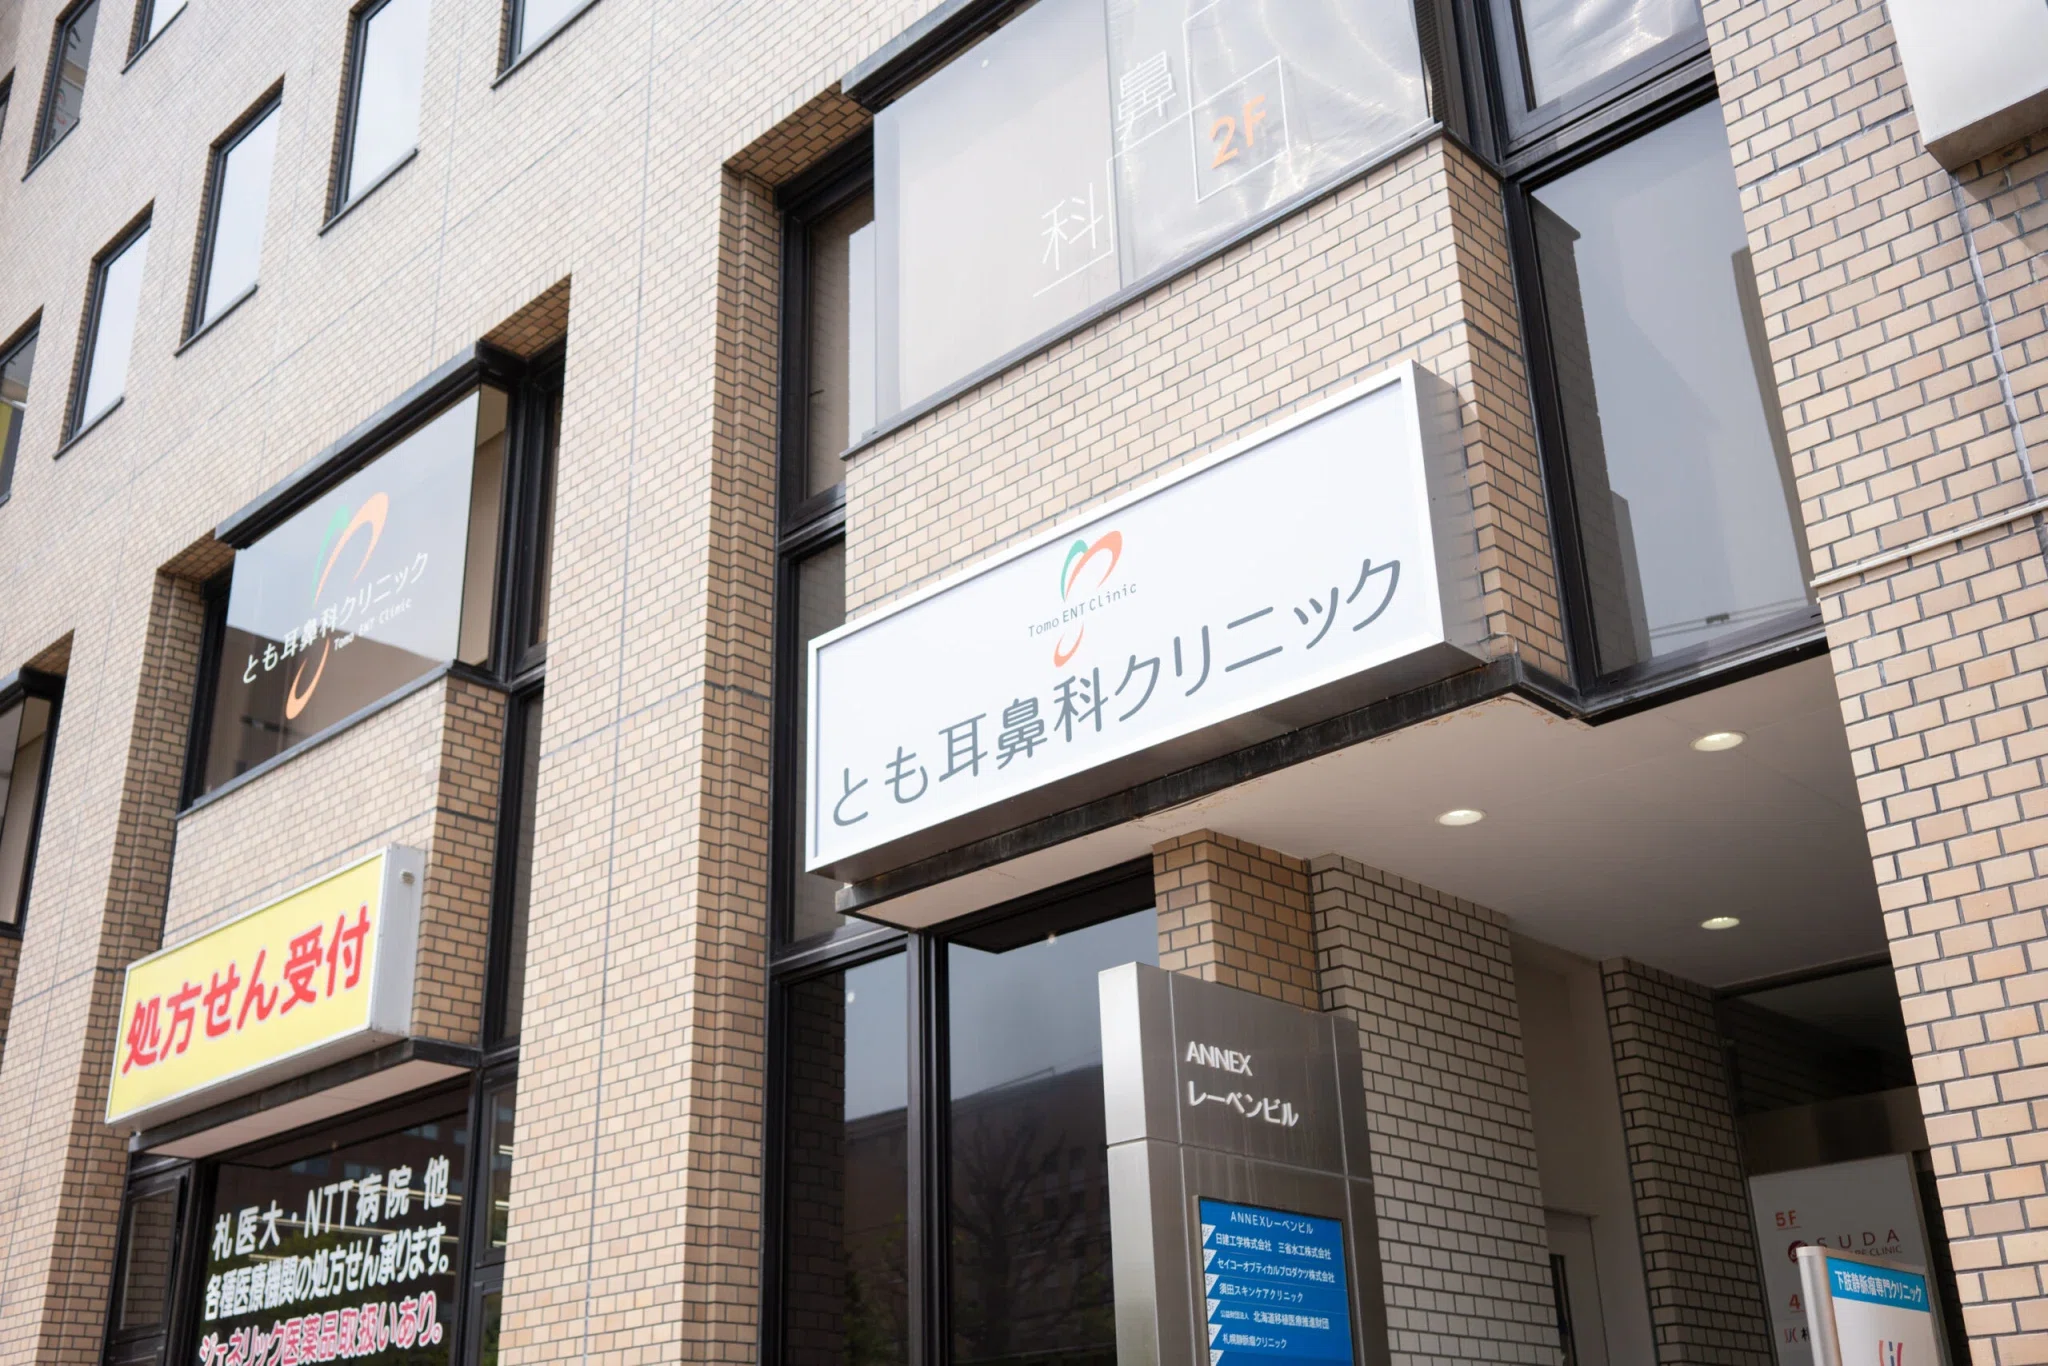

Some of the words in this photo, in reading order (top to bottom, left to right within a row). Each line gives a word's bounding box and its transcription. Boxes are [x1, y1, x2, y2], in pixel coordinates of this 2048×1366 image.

[1209, 94, 1267, 170] 2F
[1041, 182, 1104, 271] 科
[243, 552, 429, 684] とも耳鼻科クリニック
[1028, 617, 1059, 637] Tomo
[1062, 602, 1085, 622] ENT
[1089, 583, 1137, 611] Clinic
[334, 631, 355, 651] Tomo
[833, 558, 1401, 827] とも耳鼻科クリニック
[122, 904, 371, 1075] 処方せん受付
[1186, 1041, 1253, 1076] ANNEX
[1188, 1081, 1299, 1127] レーベンビル
[1230, 1211, 1314, 1234] ANNEXレーベンビル
[1775, 1210, 1797, 1227] 5F
[1216, 1233, 1272, 1252] 日建工学株式会社
[1816, 1229, 1900, 1248] SUDA
[1869, 1246, 1902, 1256] CLINIC
[204, 1221, 449, 1321] 各種医療機関の処方せん承ります。
[1219, 1283, 1303, 1303] 須田スキンケアクリニック
[1789, 1293, 1801, 1309] 4
